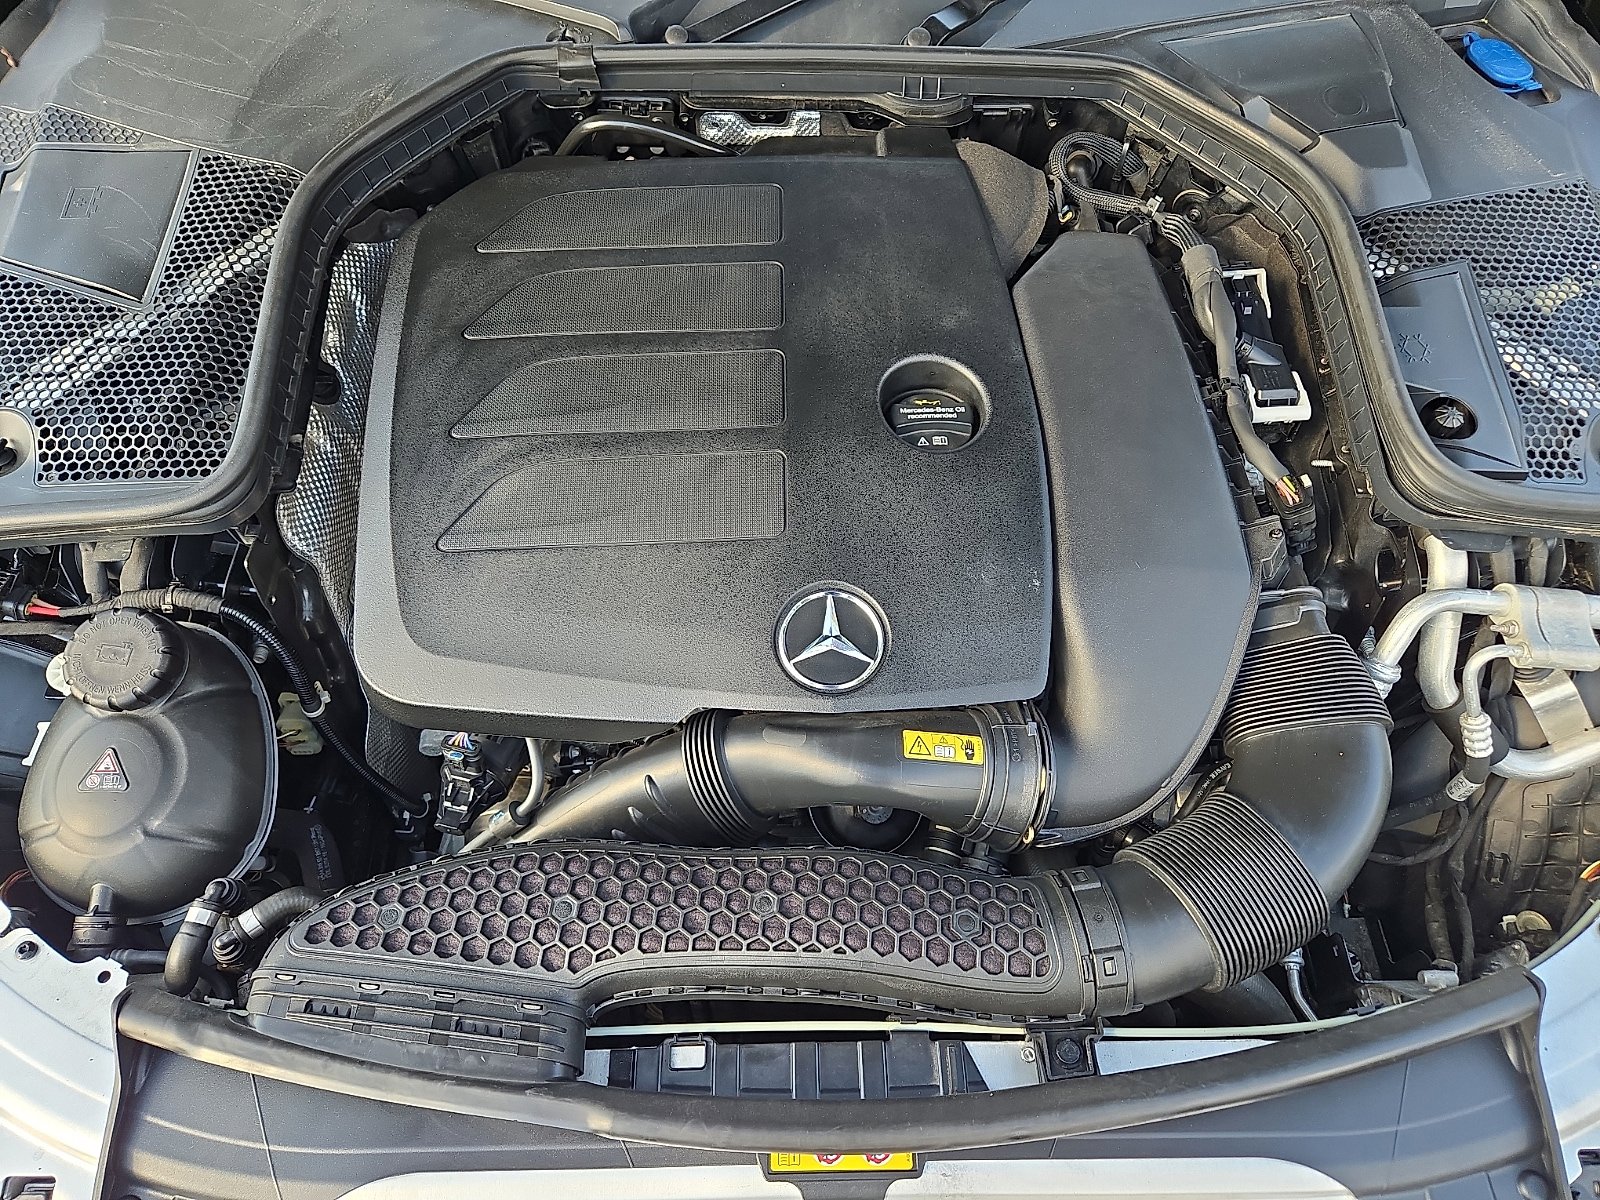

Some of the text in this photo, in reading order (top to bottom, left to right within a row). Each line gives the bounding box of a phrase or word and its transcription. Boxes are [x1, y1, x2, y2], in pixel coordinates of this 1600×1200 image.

[900, 406, 954, 414] Mercedes-Benz
[907, 412, 958, 420] recommended
[80, 632, 91, 645] DO
[90, 620, 107, 635] NOT
[109, 616, 132, 626] OPEN
[132, 620, 153, 641] WHEN
[107, 680, 132, 695] WENN
[132, 664, 152, 687] HEISS
